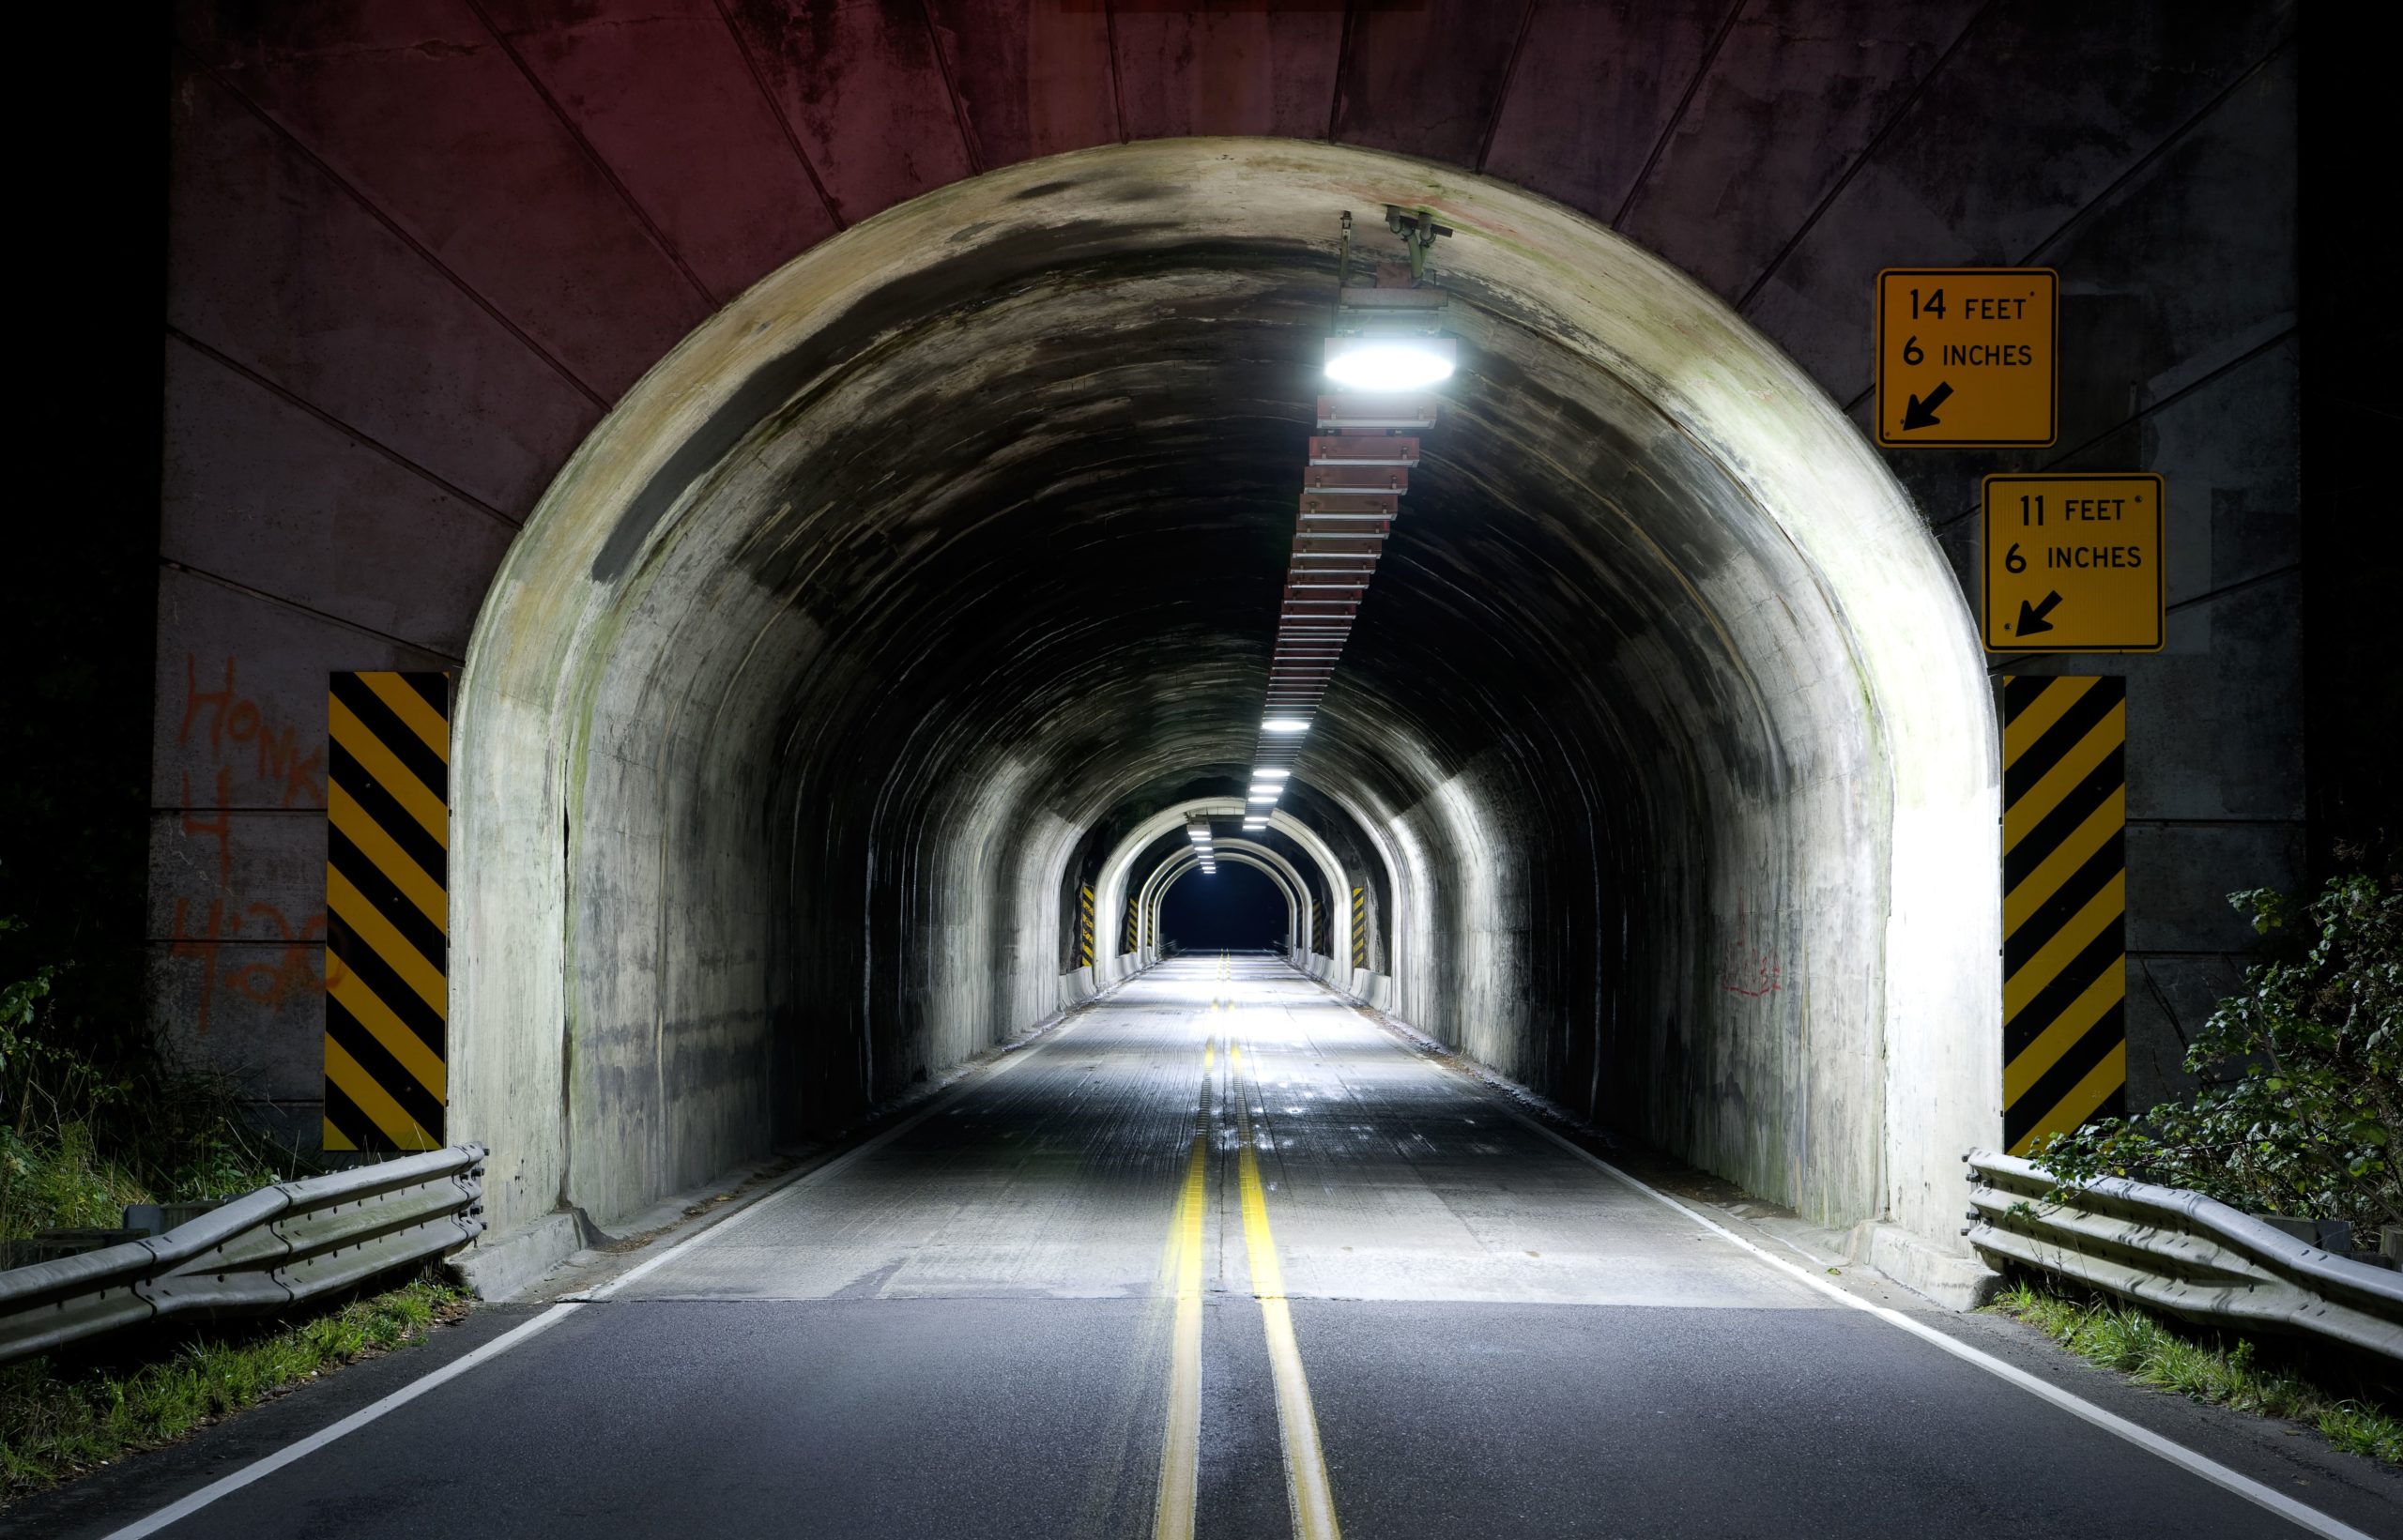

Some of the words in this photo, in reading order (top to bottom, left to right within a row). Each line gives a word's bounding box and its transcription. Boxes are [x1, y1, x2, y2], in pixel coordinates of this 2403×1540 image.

[1909, 288, 1947, 320] 14
[1964, 298, 2028, 320] FEET
[1903, 335, 1924, 366] 6
[1942, 344, 2033, 366] INCHES
[2019, 495, 2044, 526] 11
[2064, 498, 2126, 521] FEET
[2005, 542, 2028, 574] 6
[2047, 546, 2142, 569] INCHES
